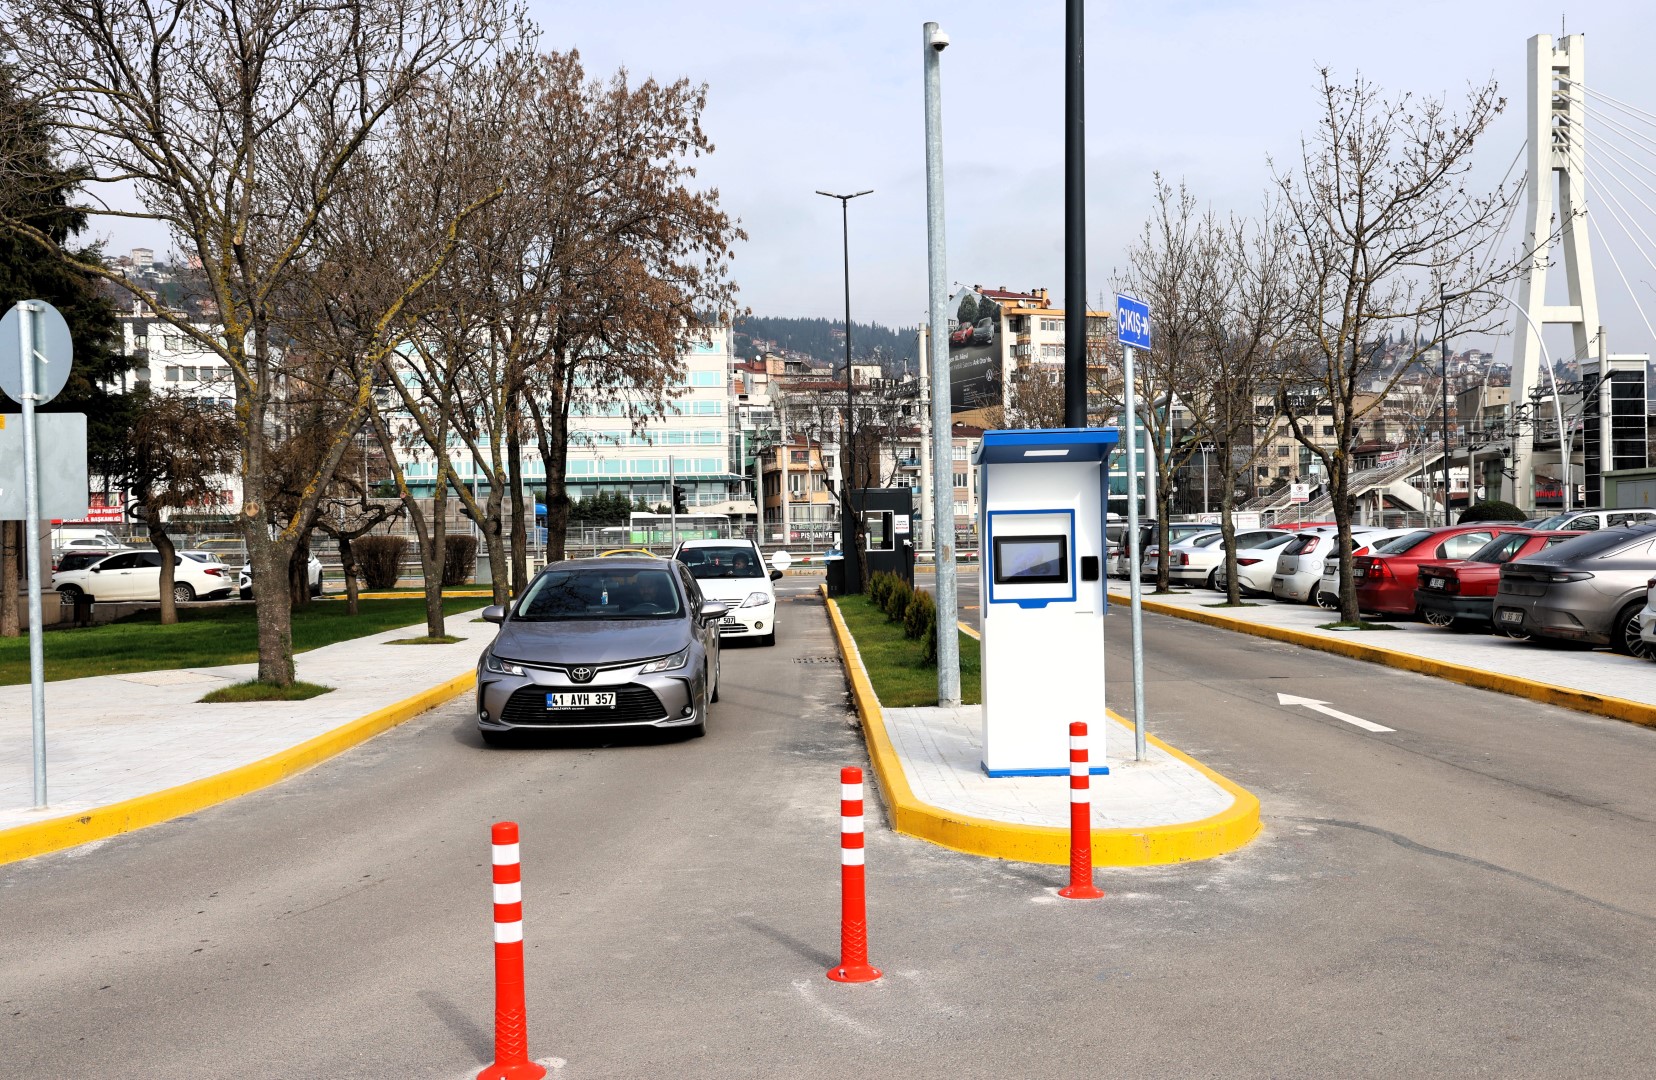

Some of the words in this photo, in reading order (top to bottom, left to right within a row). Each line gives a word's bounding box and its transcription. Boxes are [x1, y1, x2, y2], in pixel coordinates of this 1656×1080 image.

[1119, 307, 1141, 339] ÇIKIŞ
[552, 694, 564, 706] 41
[570, 693, 590, 706] AVH
[595, 693, 614, 705] 357
